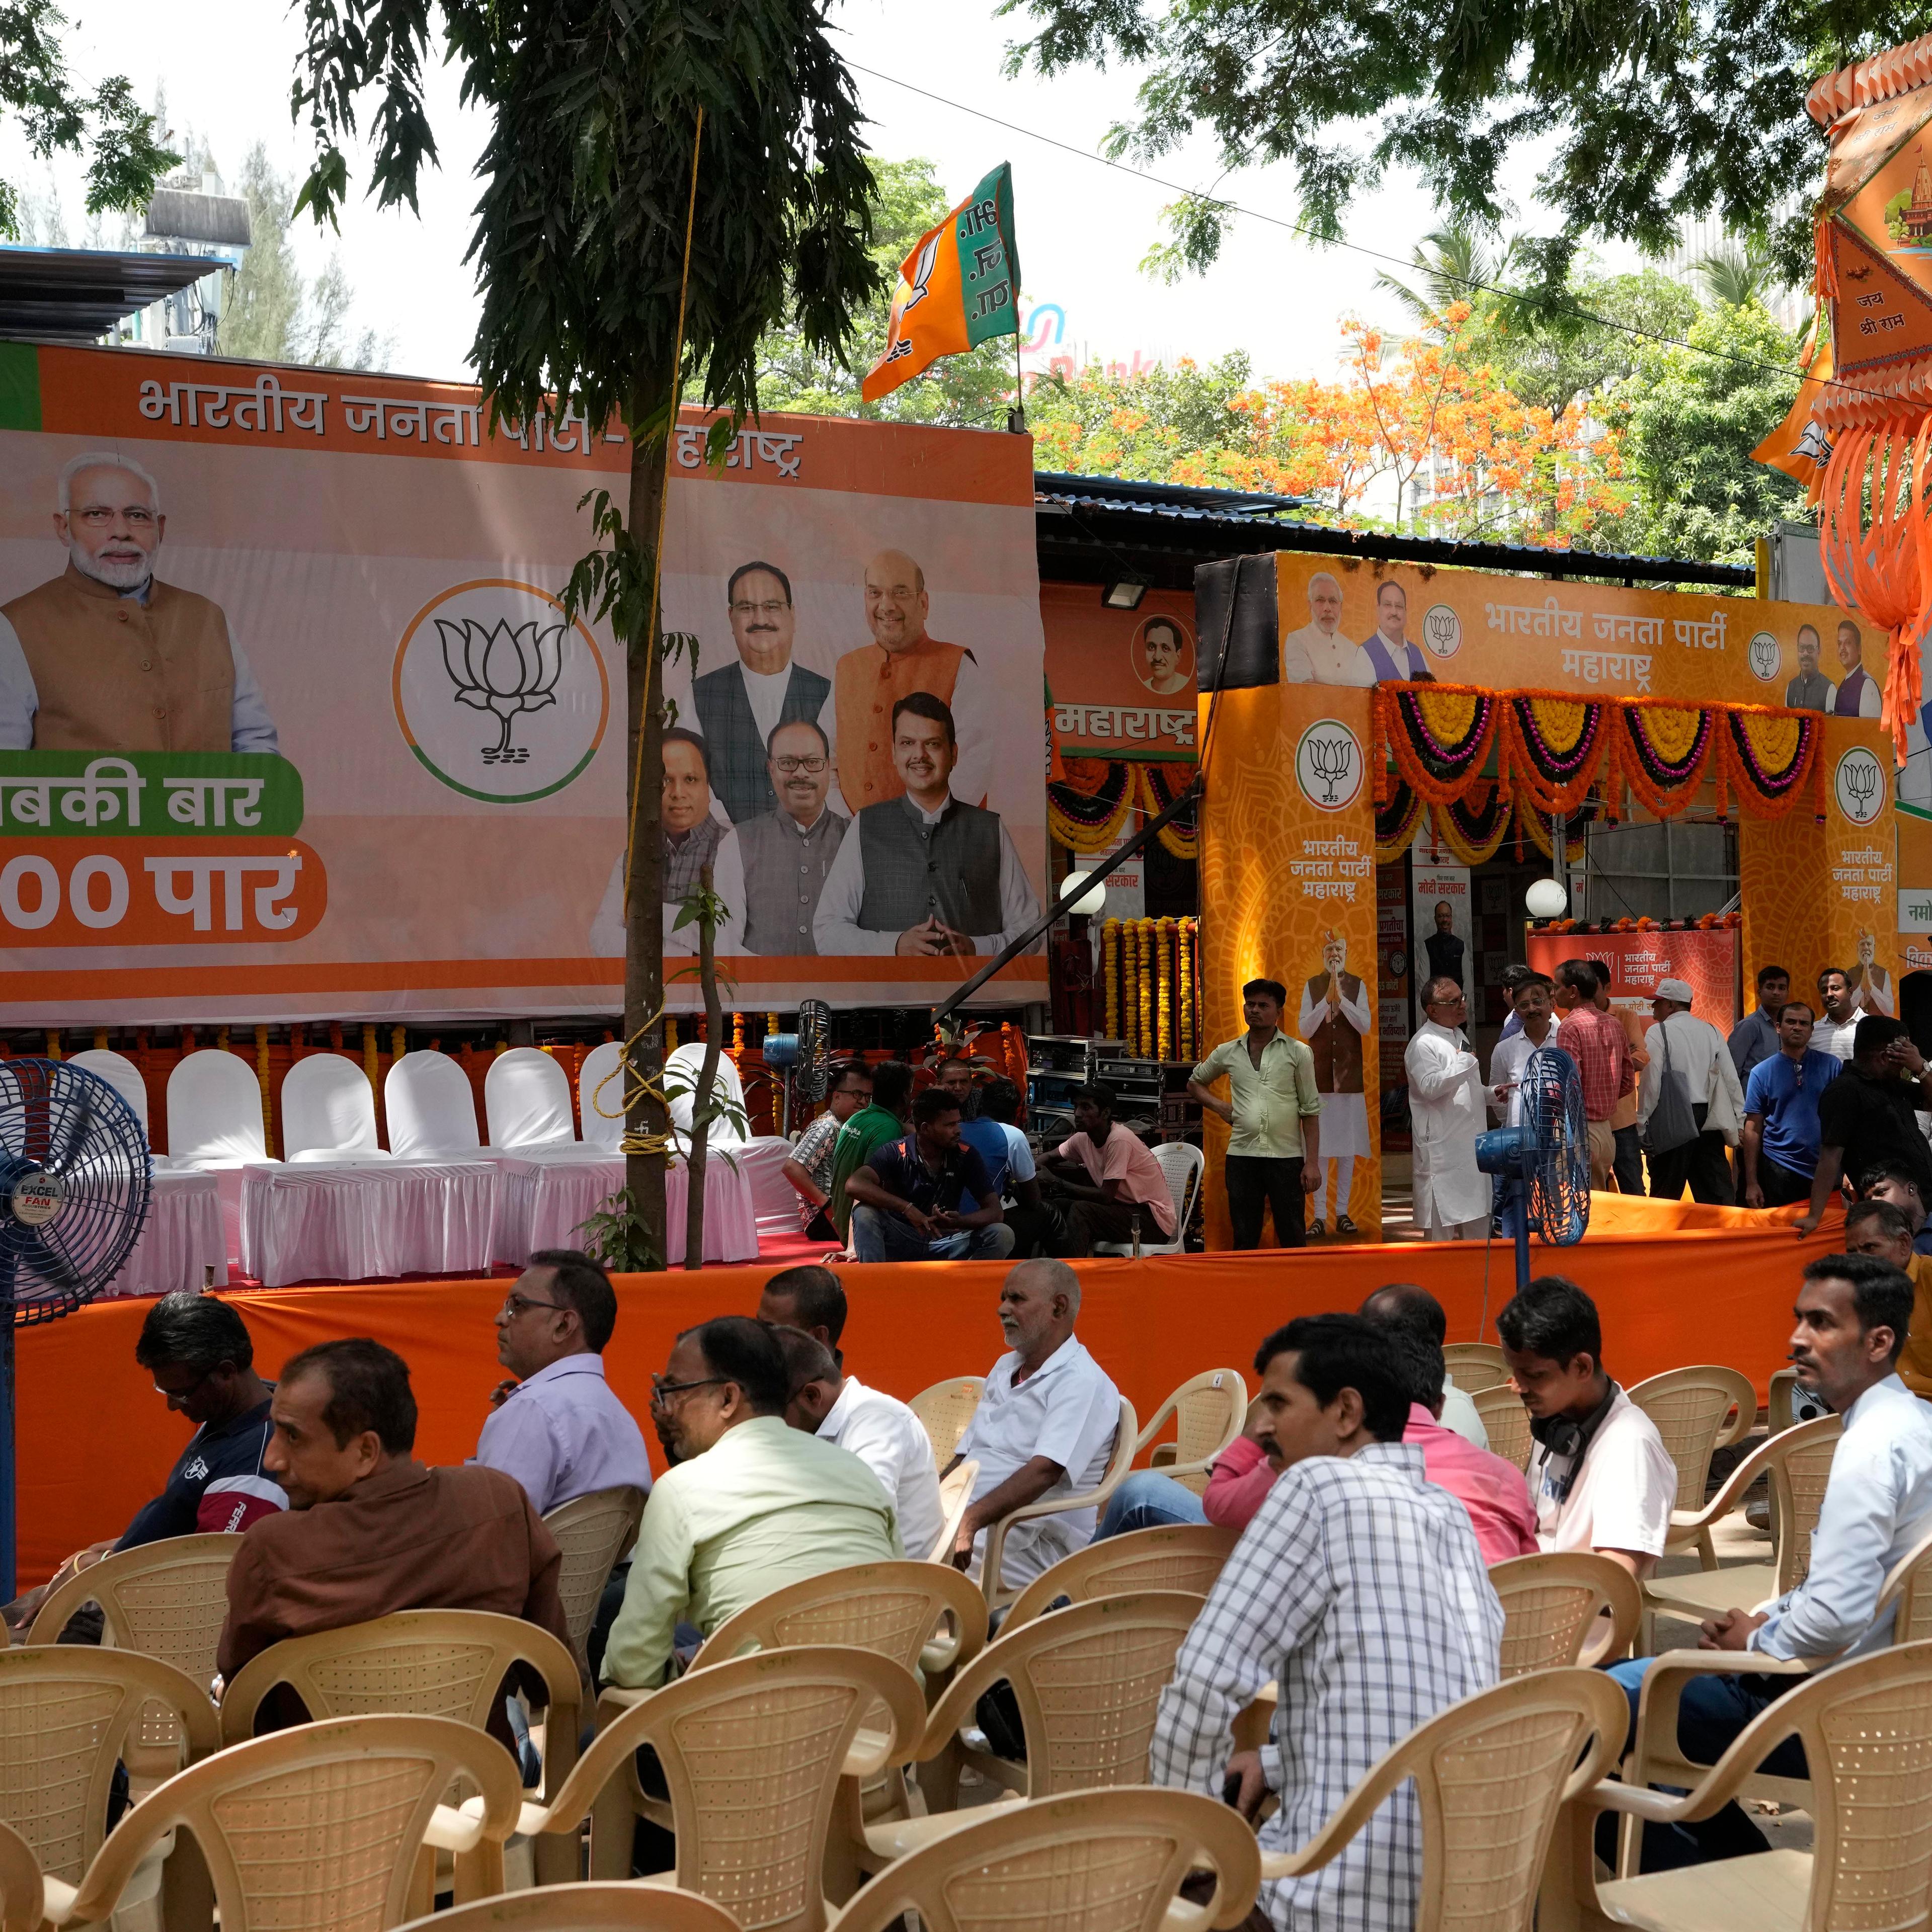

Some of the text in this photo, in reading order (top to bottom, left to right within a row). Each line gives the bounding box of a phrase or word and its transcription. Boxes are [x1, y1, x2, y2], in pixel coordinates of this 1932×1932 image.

[1873, 105, 1900, 121] जय
[1852, 122, 1898, 144] श्री राम
[1856, 292, 1884, 307] जय
[1860, 313, 1905, 336] श्री राम
[139, 374, 328, 436] भारतीय
[341, 394, 483, 446] जनता
[1485, 596, 1728, 650] भारतीय जनता पार्टी
[1561, 649, 1652, 692] महाराष्ट्र
[1054, 703, 1197, 745] महाराष्ट्र
[0, 757, 265, 827] बकी बार
[1303, 834, 1358, 856] भारतीय
[1841, 845, 1882, 864] भारतीय
[1290, 855, 1372, 876] जनता पार्टी
[1832, 864, 1893, 882] जनता पार्टी
[144, 855, 302, 931] पार
[1302, 881, 1356, 903] महाराष्ट्र
[1418, 878, 1466, 895] मोदी सरकार
[1842, 886, 1881, 904] महाराष्ट्र
[1625, 950, 1656, 962] भारतीय
[1625, 960, 1671, 973] जनता पार्टी
[1625, 975, 1655, 986] महाराष्ट्र
[1629, 1000, 1644, 1011] मोदी
[21, 1184, 57, 1197] EXCEL
[25, 1196, 50, 1205] FAN
